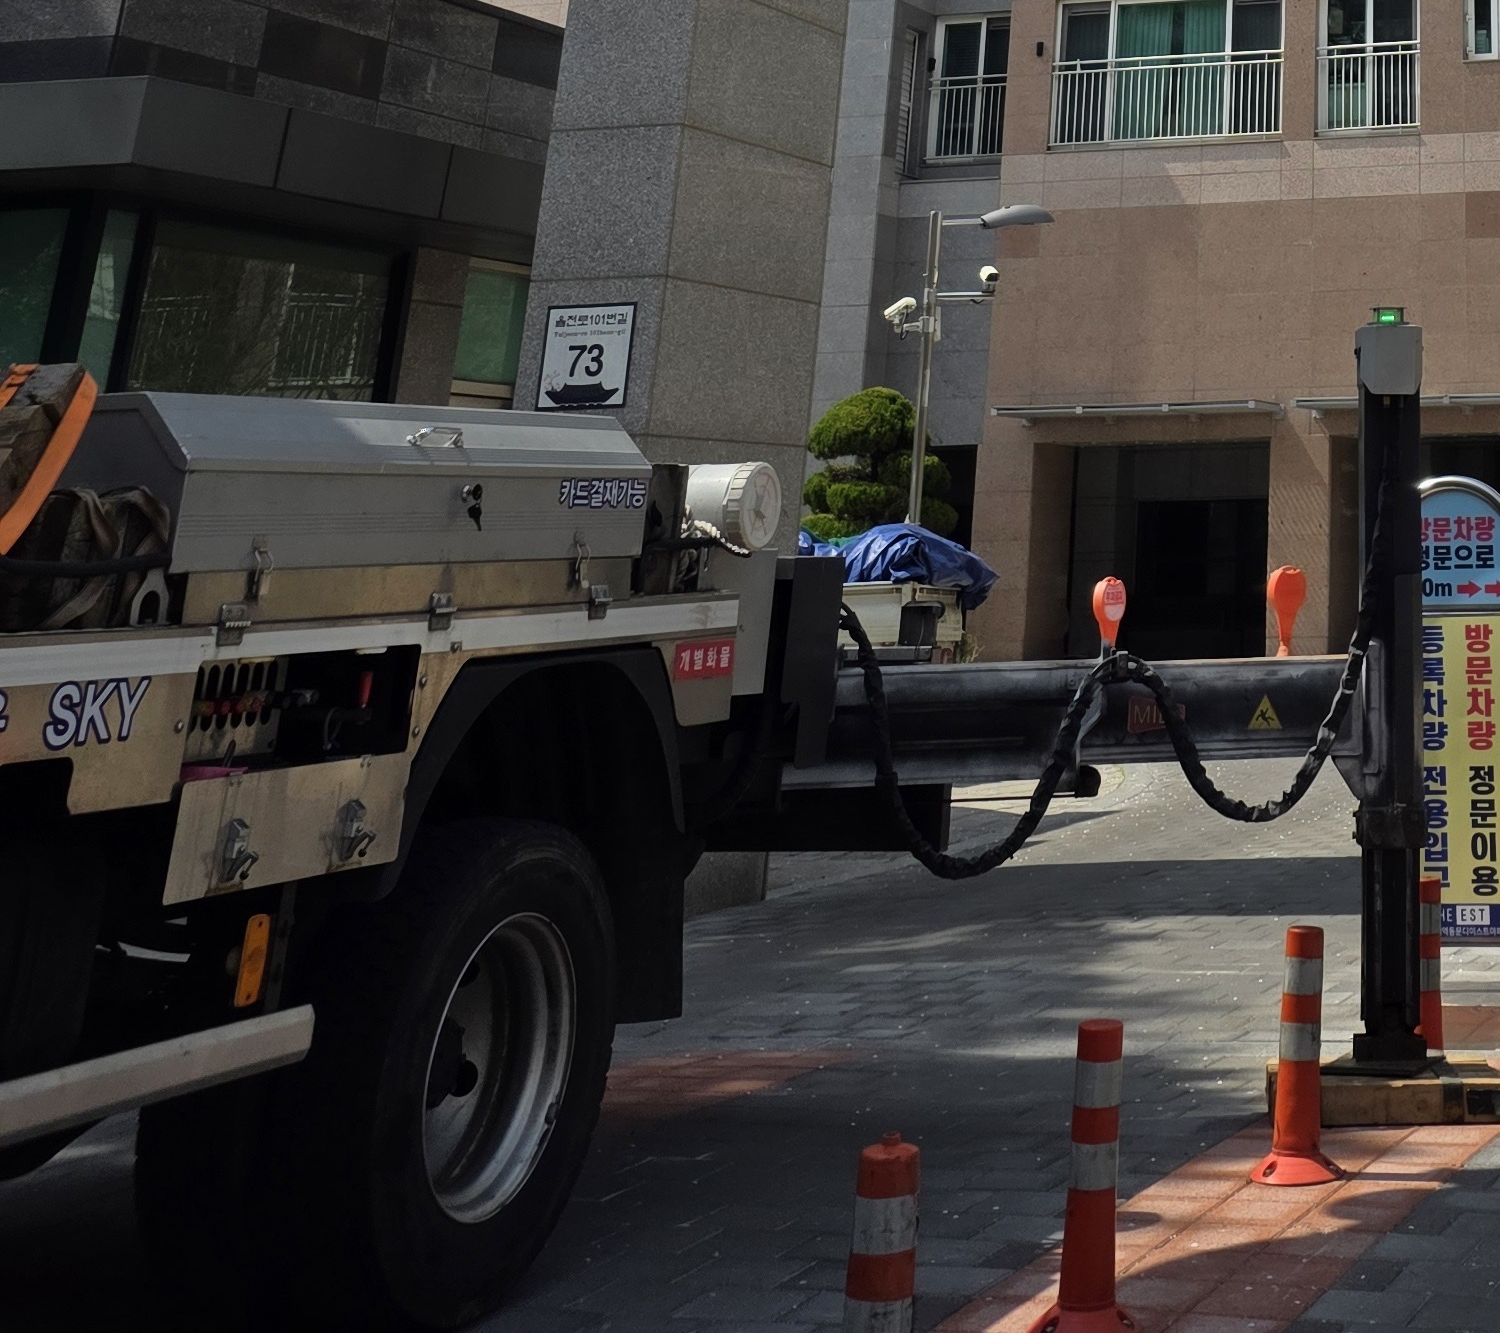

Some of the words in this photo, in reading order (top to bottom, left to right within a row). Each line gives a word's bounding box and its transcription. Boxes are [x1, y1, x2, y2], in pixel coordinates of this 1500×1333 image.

[568, 343, 605, 378] 73
[559, 479, 647, 508] 카드결재가능
[1421, 577, 1453, 598] 0m
[679, 645, 731, 672] 개별화물
[1422, 625, 1449, 751] 등록차량
[1465, 623, 1497, 751] 방문차량
[42, 675, 152, 752] SKY
[1469, 765, 1500, 897] 정문이용
[1441, 908, 1453, 923] HE
[1460, 908, 1486, 922] EST
